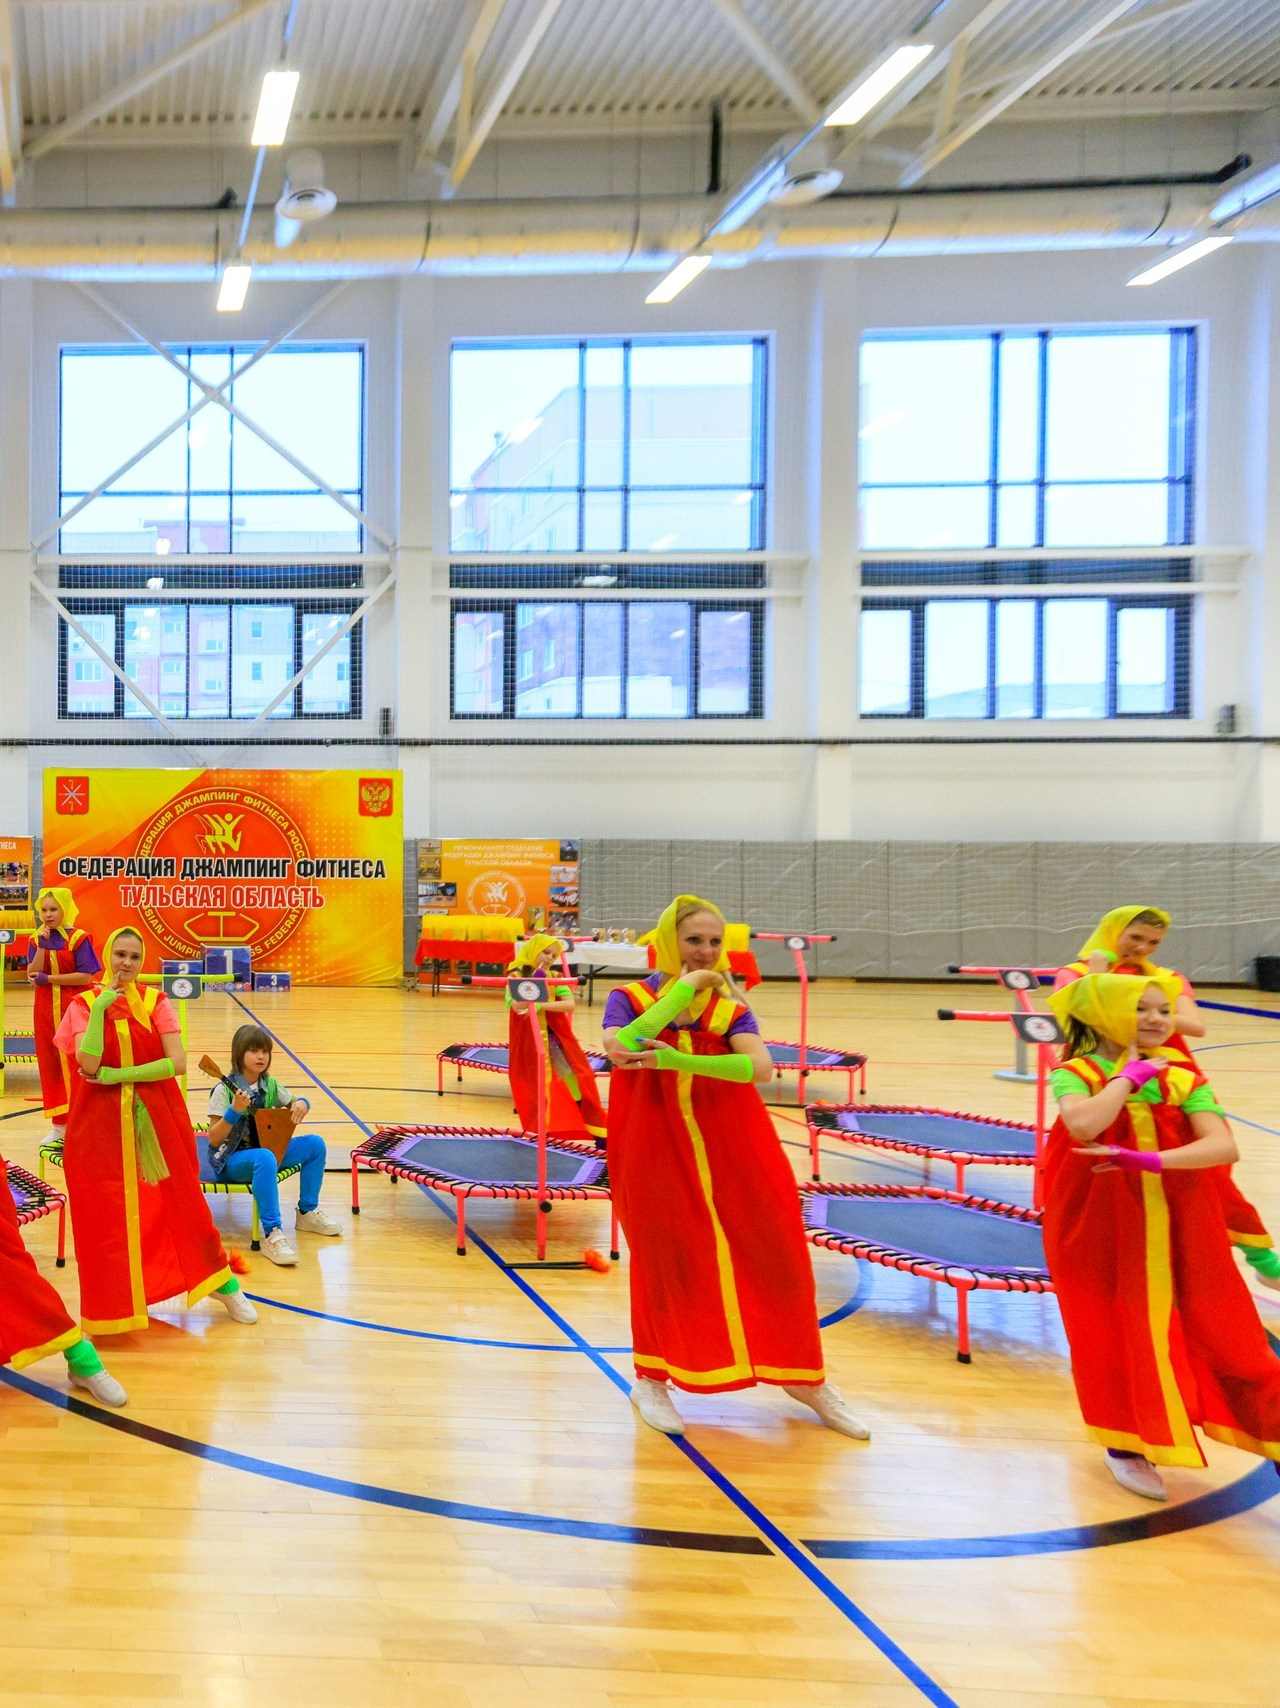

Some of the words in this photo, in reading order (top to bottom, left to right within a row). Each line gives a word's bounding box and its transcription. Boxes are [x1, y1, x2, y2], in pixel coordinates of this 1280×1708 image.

[139, 812, 174, 857] ДЕРАЦИЯ
[175, 791, 241, 815] ДЖАМПИНГ
[243, 795, 291, 831] ФИТНЕСА
[286, 829, 307, 859] РОСС
[58, 857, 176, 880] ФЕДЕРАЦИЯ
[180, 857, 292, 881] ДЖАМПИНГ
[295, 857, 387, 879] ФИТНЕСА
[120, 885, 226, 908] ТУЛЬСКАЯ
[230, 885, 326, 908] ОБЛАСТЬ
[264, 908, 301, 949] FEDERAT
[163, 934, 201, 959] JUMPIN
[178, 963, 189, 975] 2
[223, 949, 234, 974] 1
[270, 974, 278, 986] 3
